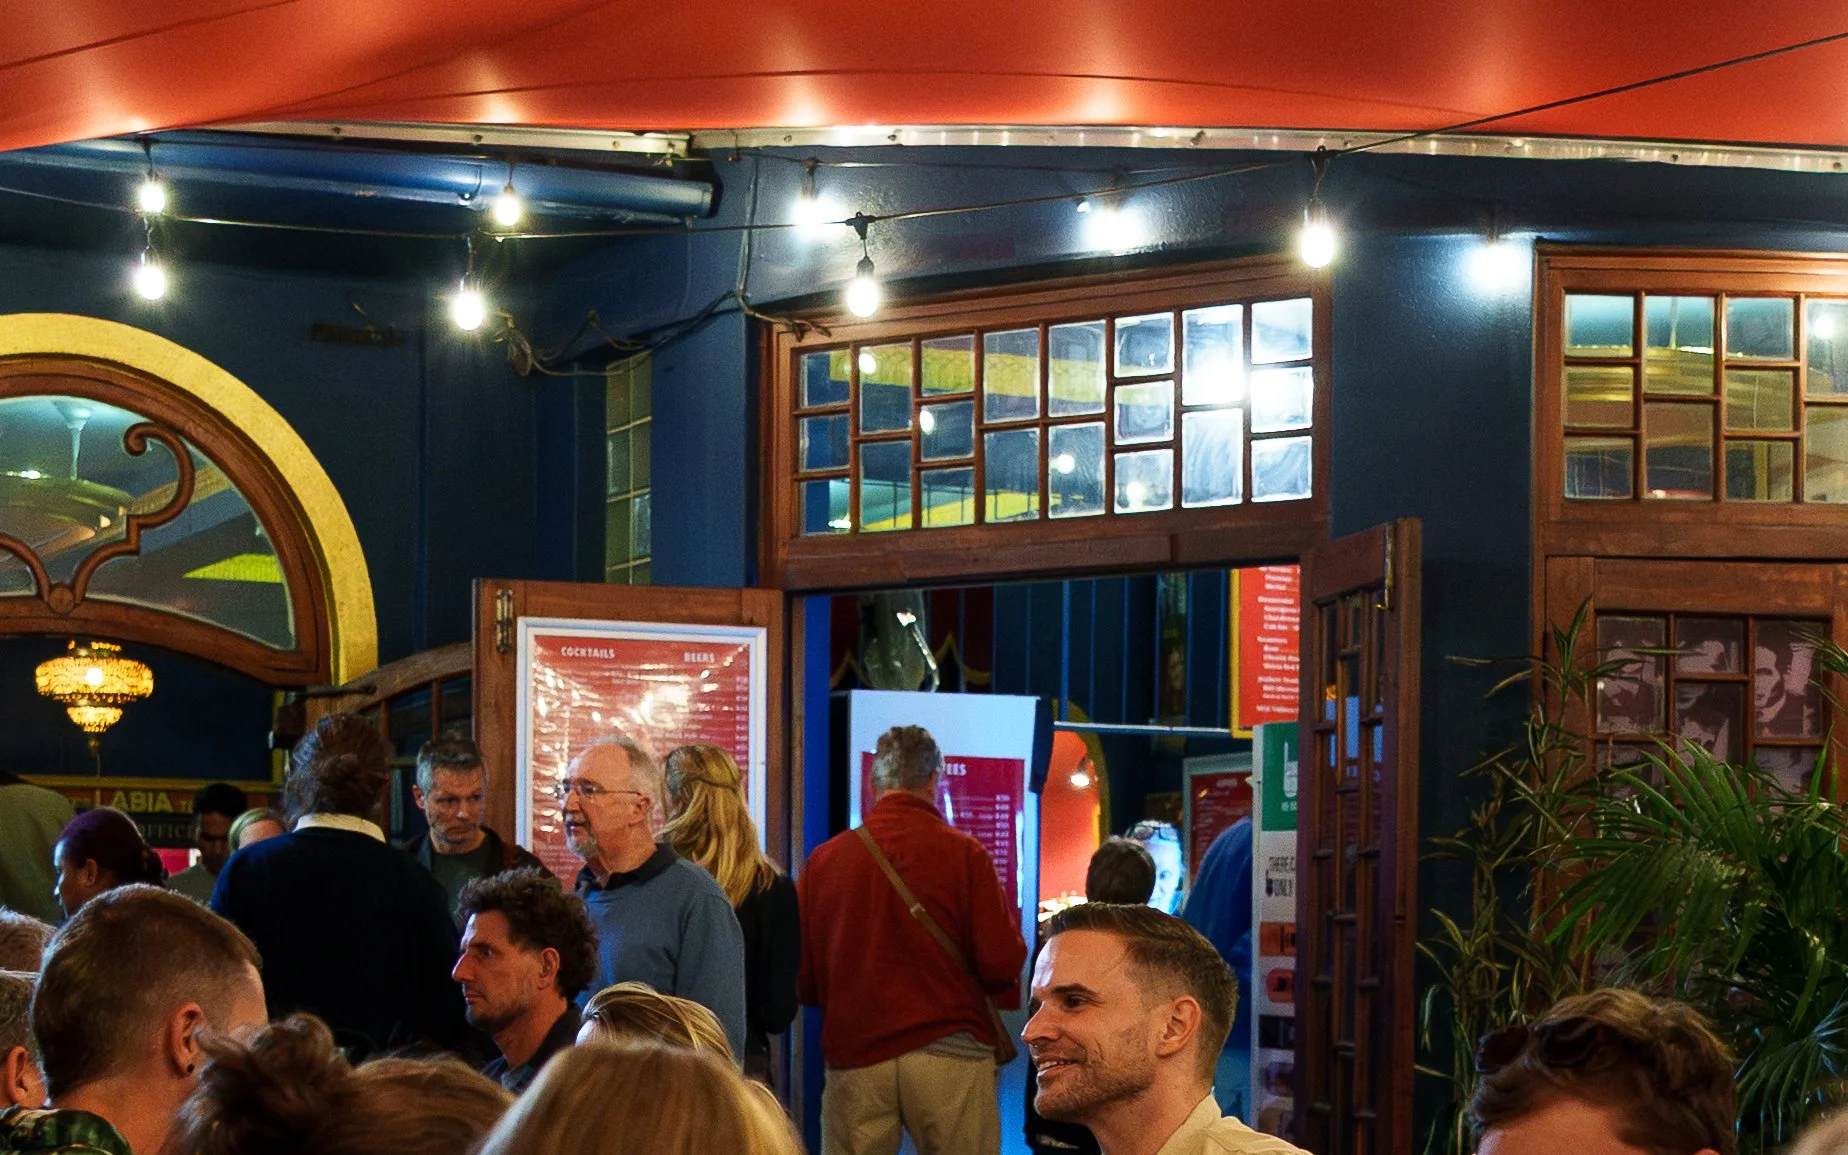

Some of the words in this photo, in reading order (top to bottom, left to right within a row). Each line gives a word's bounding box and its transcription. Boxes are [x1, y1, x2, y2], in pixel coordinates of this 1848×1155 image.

[561, 646, 615, 659] COCKTAILS
[684, 651, 715, 664] BEERS
[95, 790, 174, 813] LABIA
